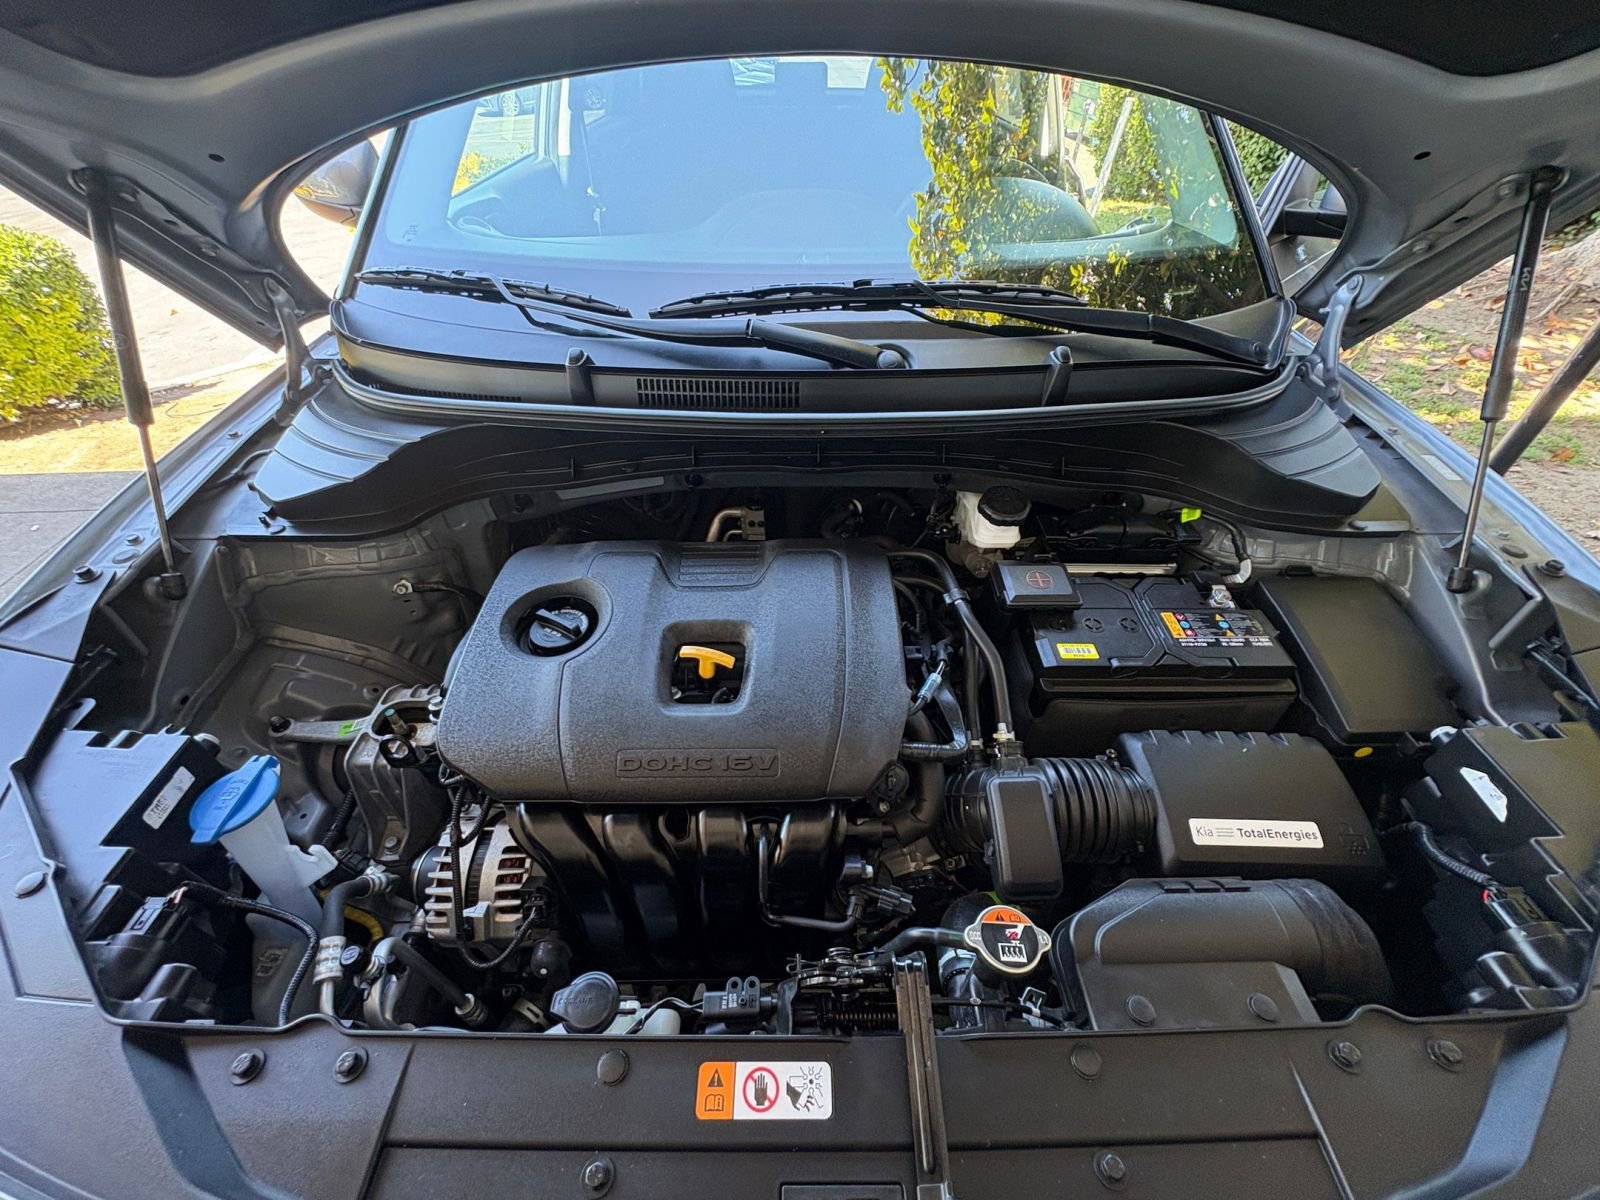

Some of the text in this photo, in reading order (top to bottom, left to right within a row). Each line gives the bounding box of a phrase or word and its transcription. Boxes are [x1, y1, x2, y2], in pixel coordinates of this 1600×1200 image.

[618, 755, 777, 771] DOHC 16V
[1195, 826, 1318, 841] Kia TotalEnergies
